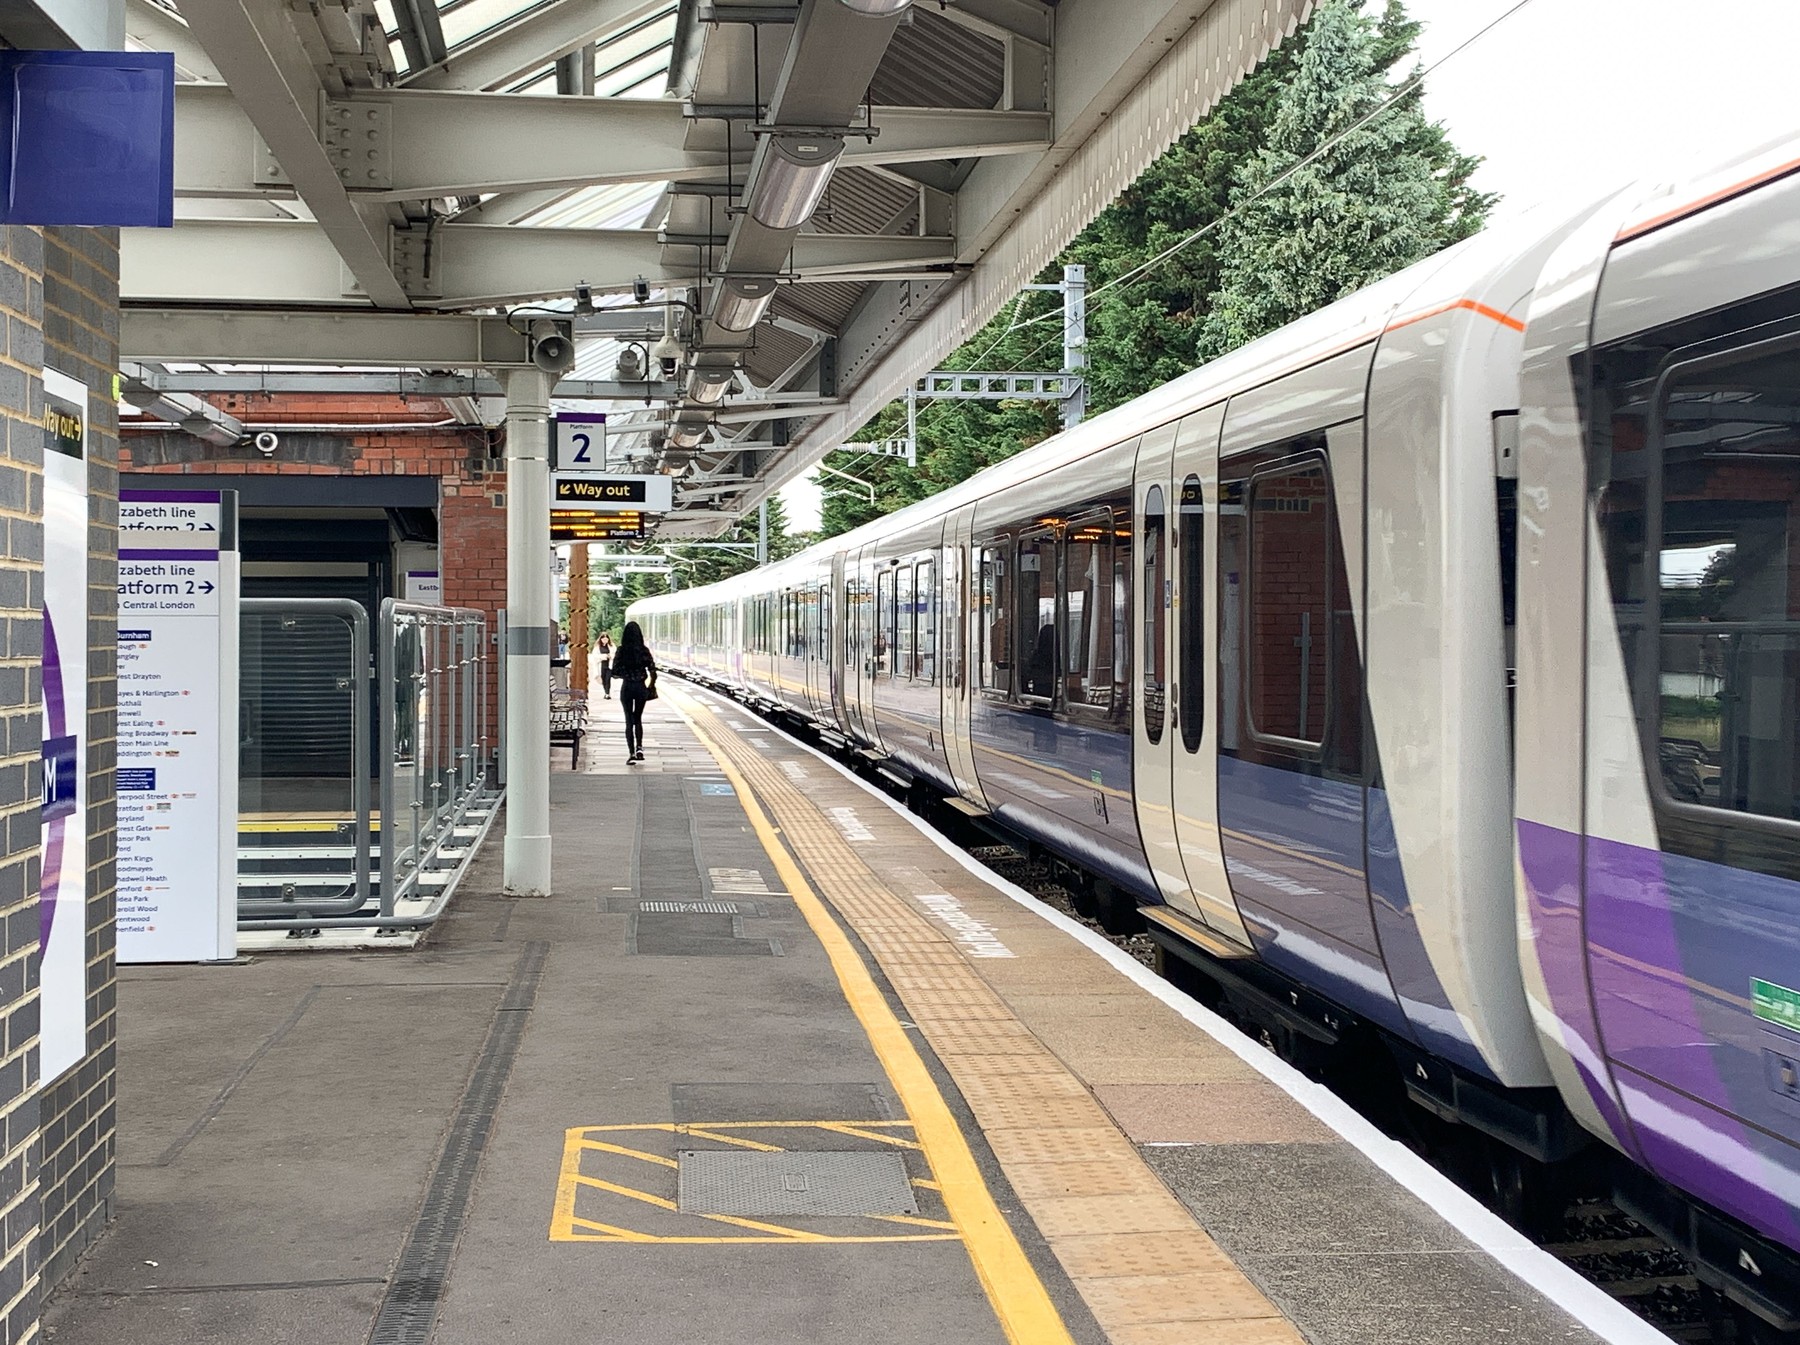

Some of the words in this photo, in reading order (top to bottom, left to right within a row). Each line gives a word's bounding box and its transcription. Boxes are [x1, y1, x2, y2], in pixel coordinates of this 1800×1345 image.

[60, 415, 74, 440] out
[572, 433, 591, 463] 2
[573, 483, 603, 498] Way
[606, 485, 630, 496] out
[120, 506, 167, 518] zabeth
[171, 506, 196, 518] line
[119, 564, 166, 576] zabeth
[170, 564, 196, 576] line
[117, 579, 179, 595] atform
[185, 580, 195, 595] 2
[123, 600, 158, 609] Central
[160, 600, 196, 609] London
[132, 673, 162, 681] Drayton
[142, 690, 180, 698] Harlington
[132, 720, 154, 728] Ealing
[135, 730, 169, 738] Broadway
